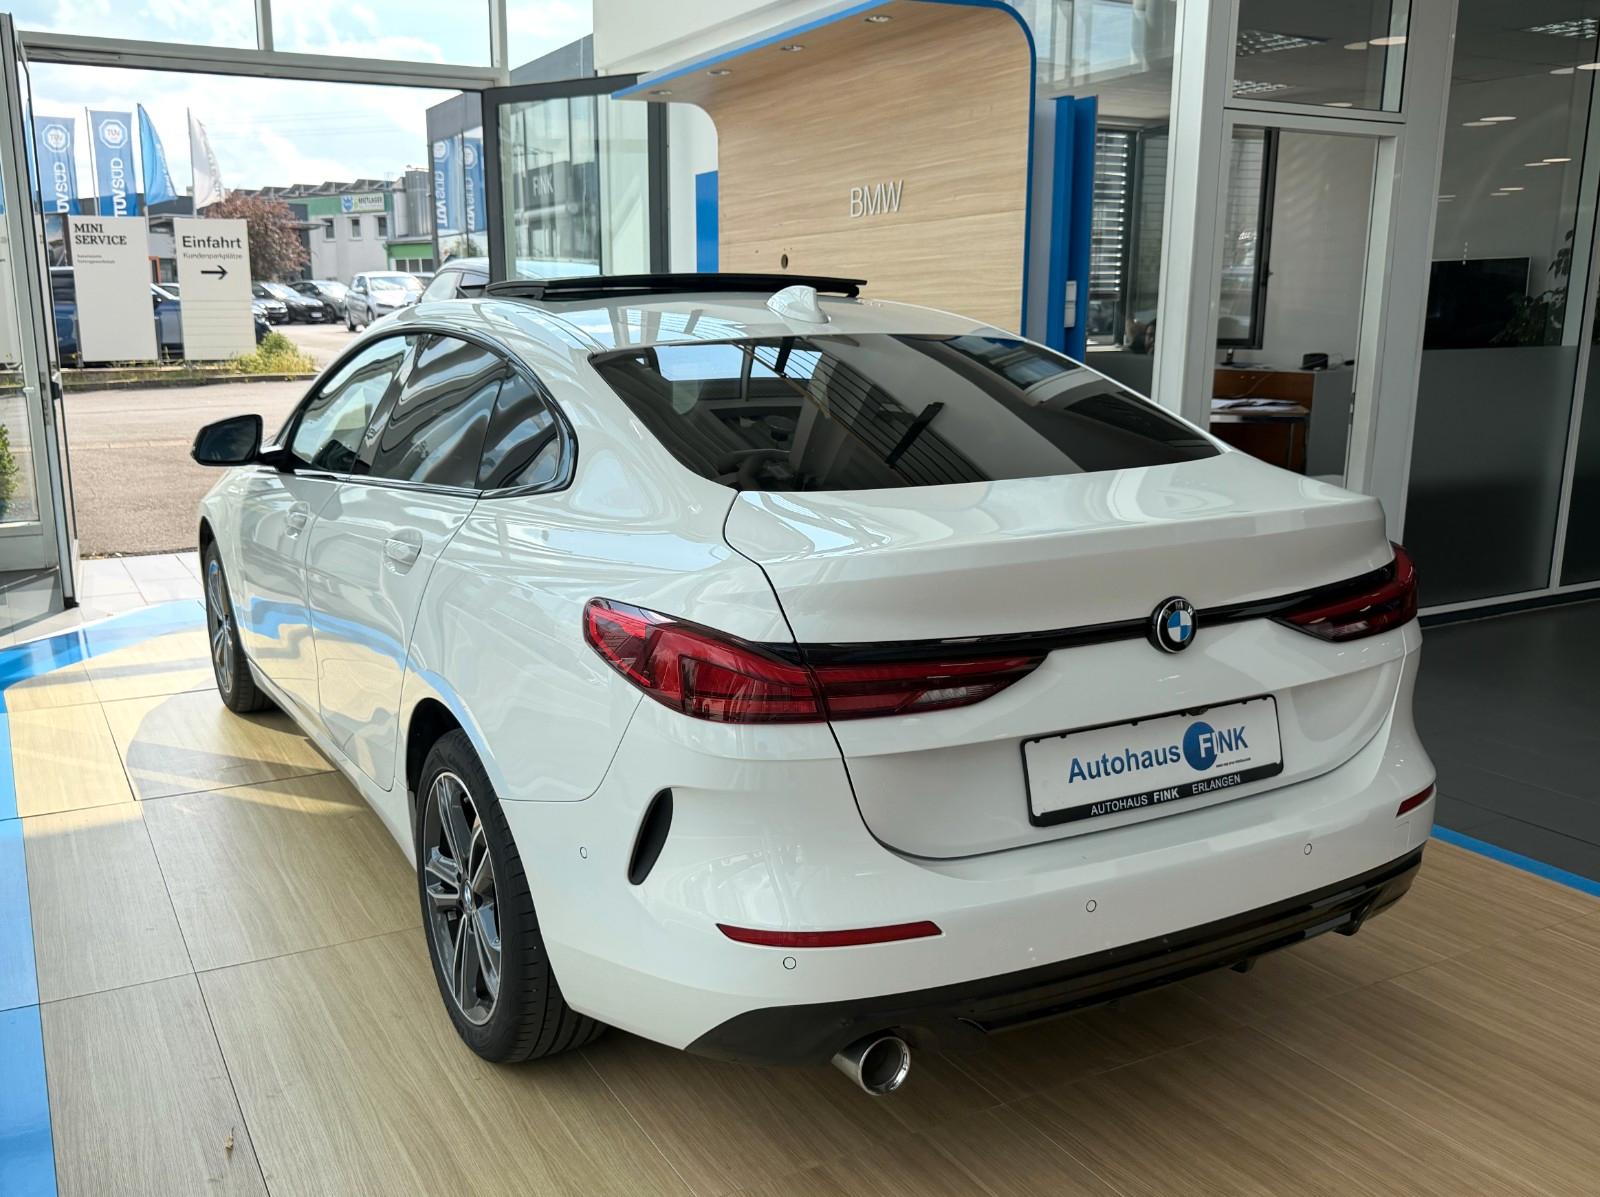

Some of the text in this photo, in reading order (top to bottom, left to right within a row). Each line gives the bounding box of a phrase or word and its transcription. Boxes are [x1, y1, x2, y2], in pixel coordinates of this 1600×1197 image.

[850, 180, 903, 217] BMW
[74, 223, 104, 233] MINI
[75, 235, 127, 246] SERVICE
[182, 235, 242, 248] Einfahrt
[1068, 726, 1249, 784] Autohaus FINK
[1090, 774, 1241, 816] AUTOHAUS FINK ERLANGEN
